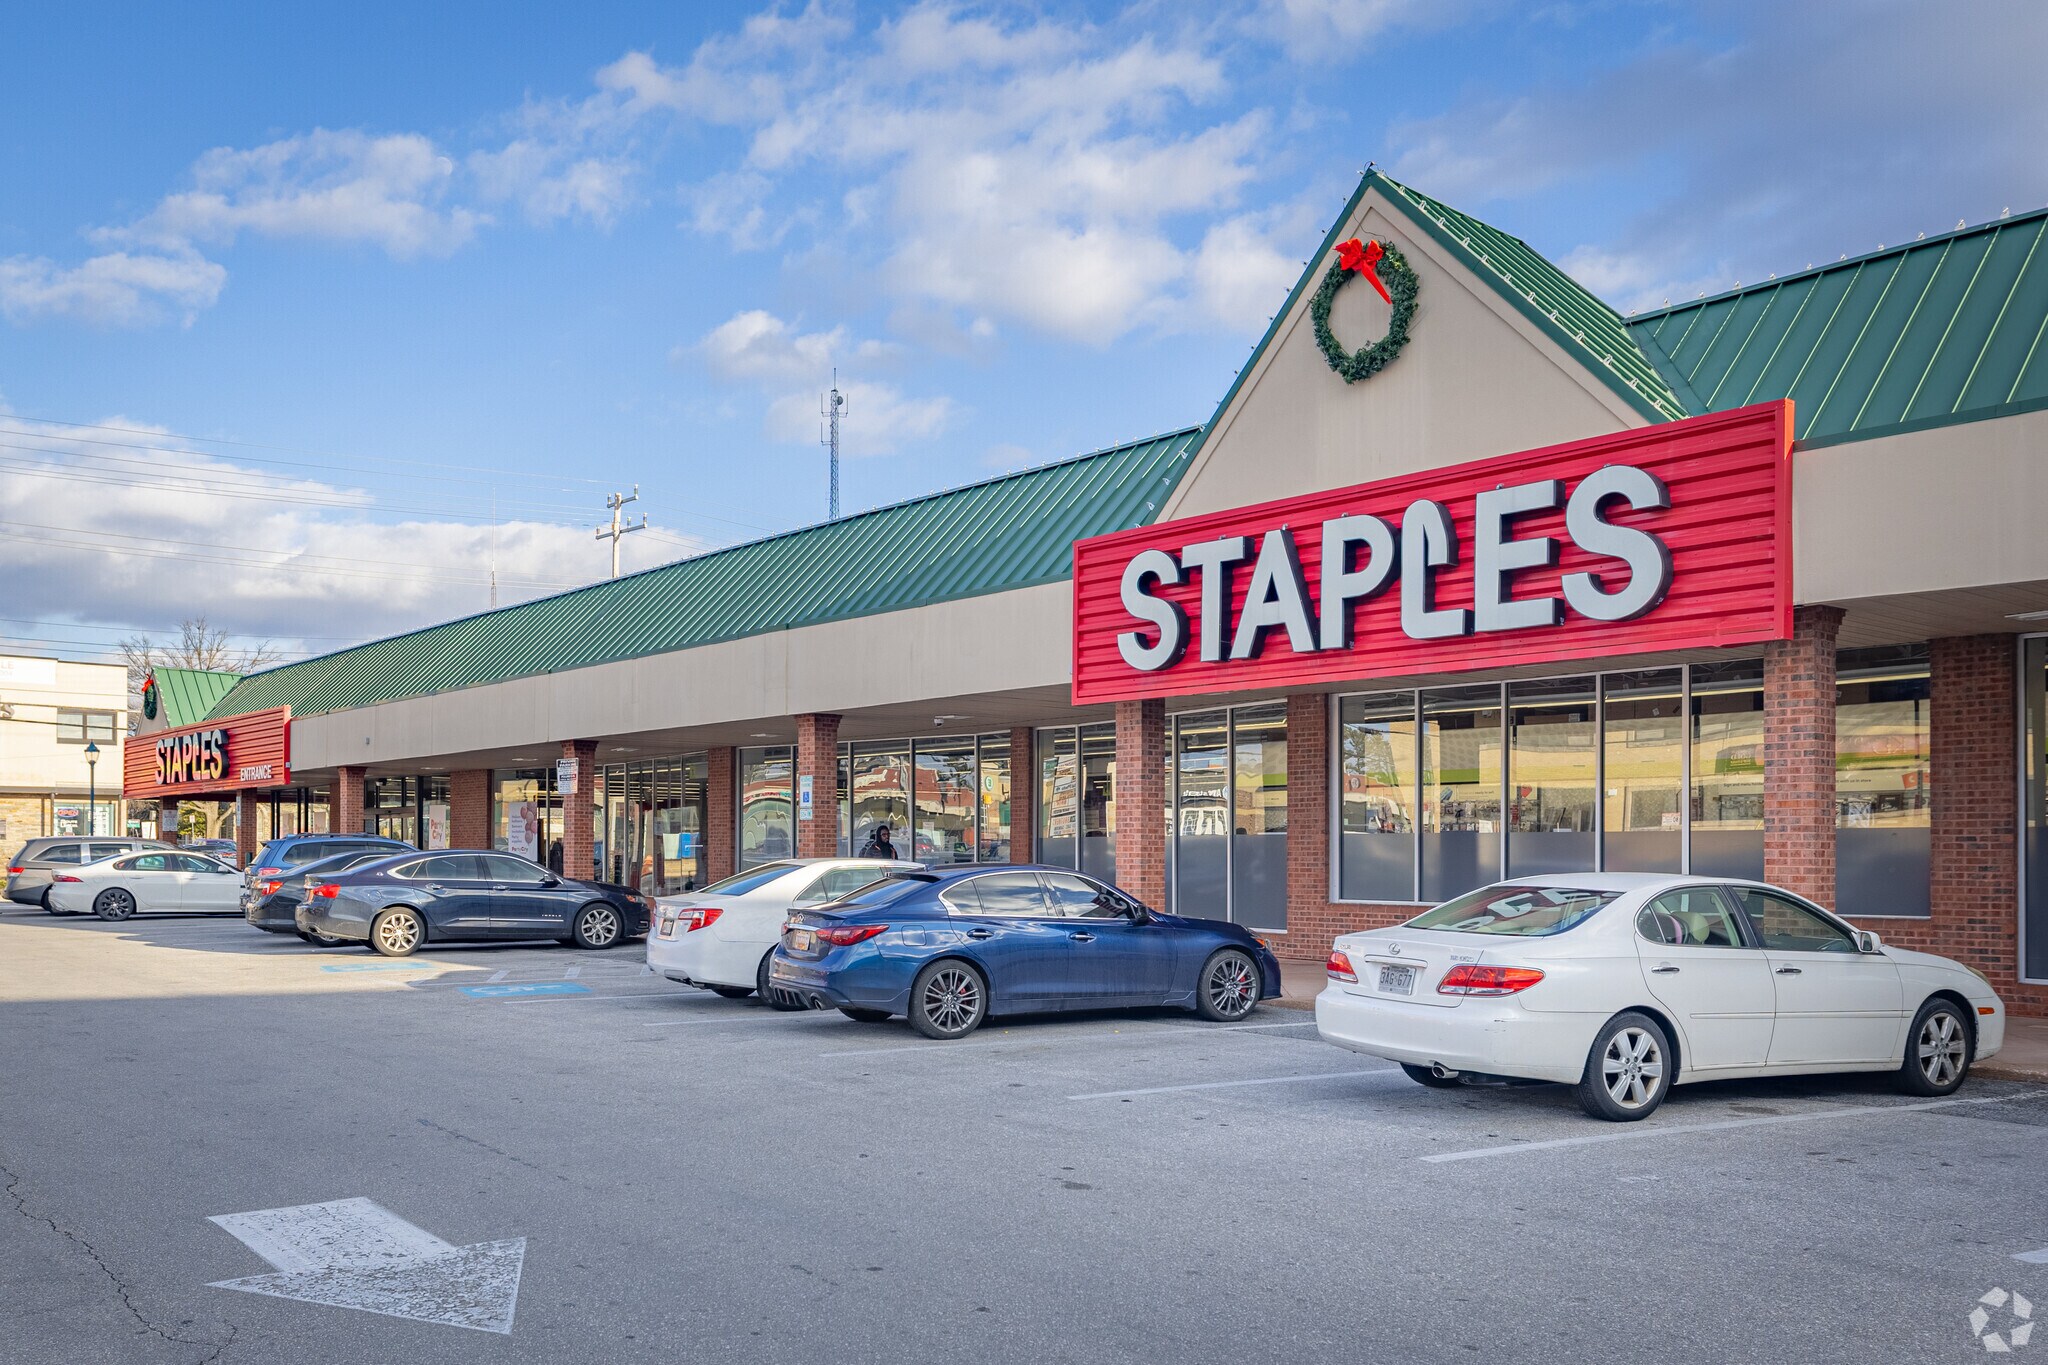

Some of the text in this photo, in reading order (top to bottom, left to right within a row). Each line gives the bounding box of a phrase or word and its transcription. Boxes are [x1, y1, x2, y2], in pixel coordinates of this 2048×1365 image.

[1117, 463, 1673, 672] STAPLES
[154, 728, 229, 785] STAPLES
[240, 764, 272, 781] ENTRANCE
[58, 808, 79, 817] OPEN
